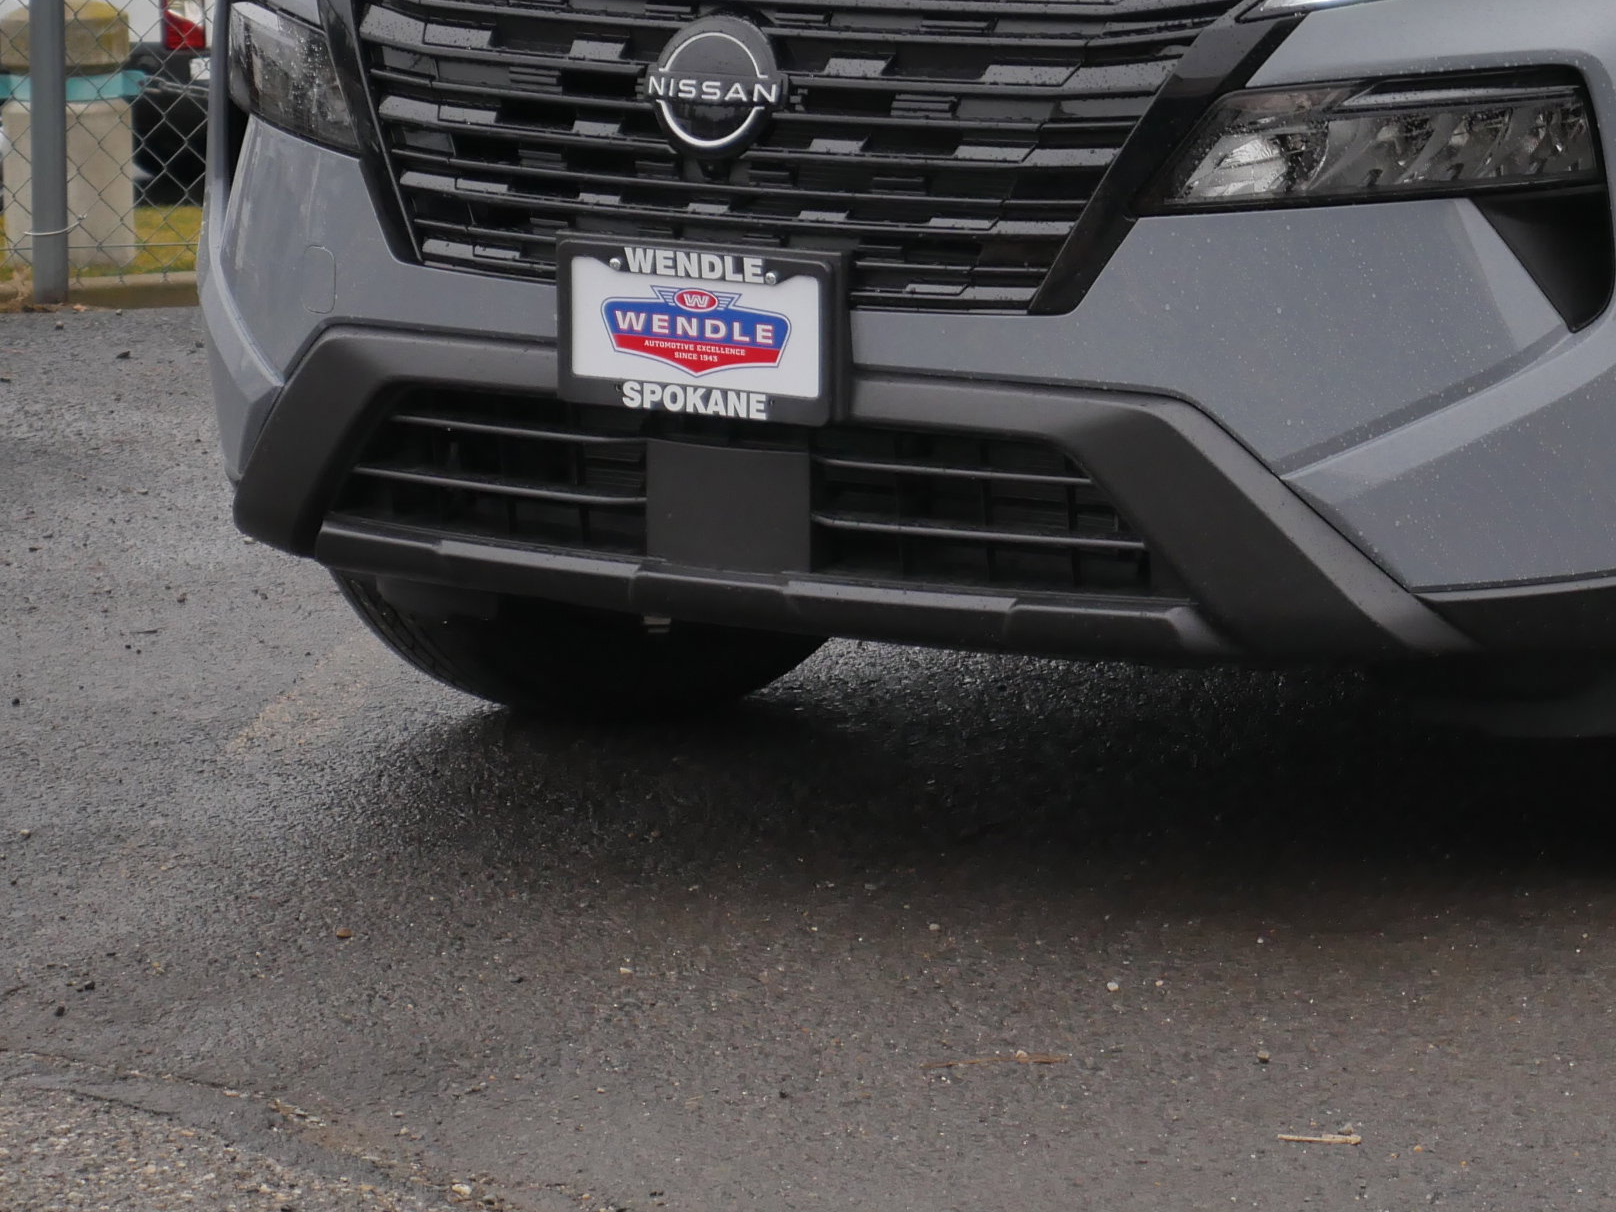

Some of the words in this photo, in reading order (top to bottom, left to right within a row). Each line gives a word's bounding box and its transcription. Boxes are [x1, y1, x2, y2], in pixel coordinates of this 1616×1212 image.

[648, 76, 777, 103] NISSAN
[624, 247, 765, 284] WENDLE
[615, 310, 773, 344] WENDLE
[644, 340, 694, 351] AUTOMOTIVE
[697, 344, 746, 356] EXCELLENCE
[674, 352, 698, 360] SINCE
[700, 354, 718, 362] 1943
[622, 381, 767, 420] SPOKANE
